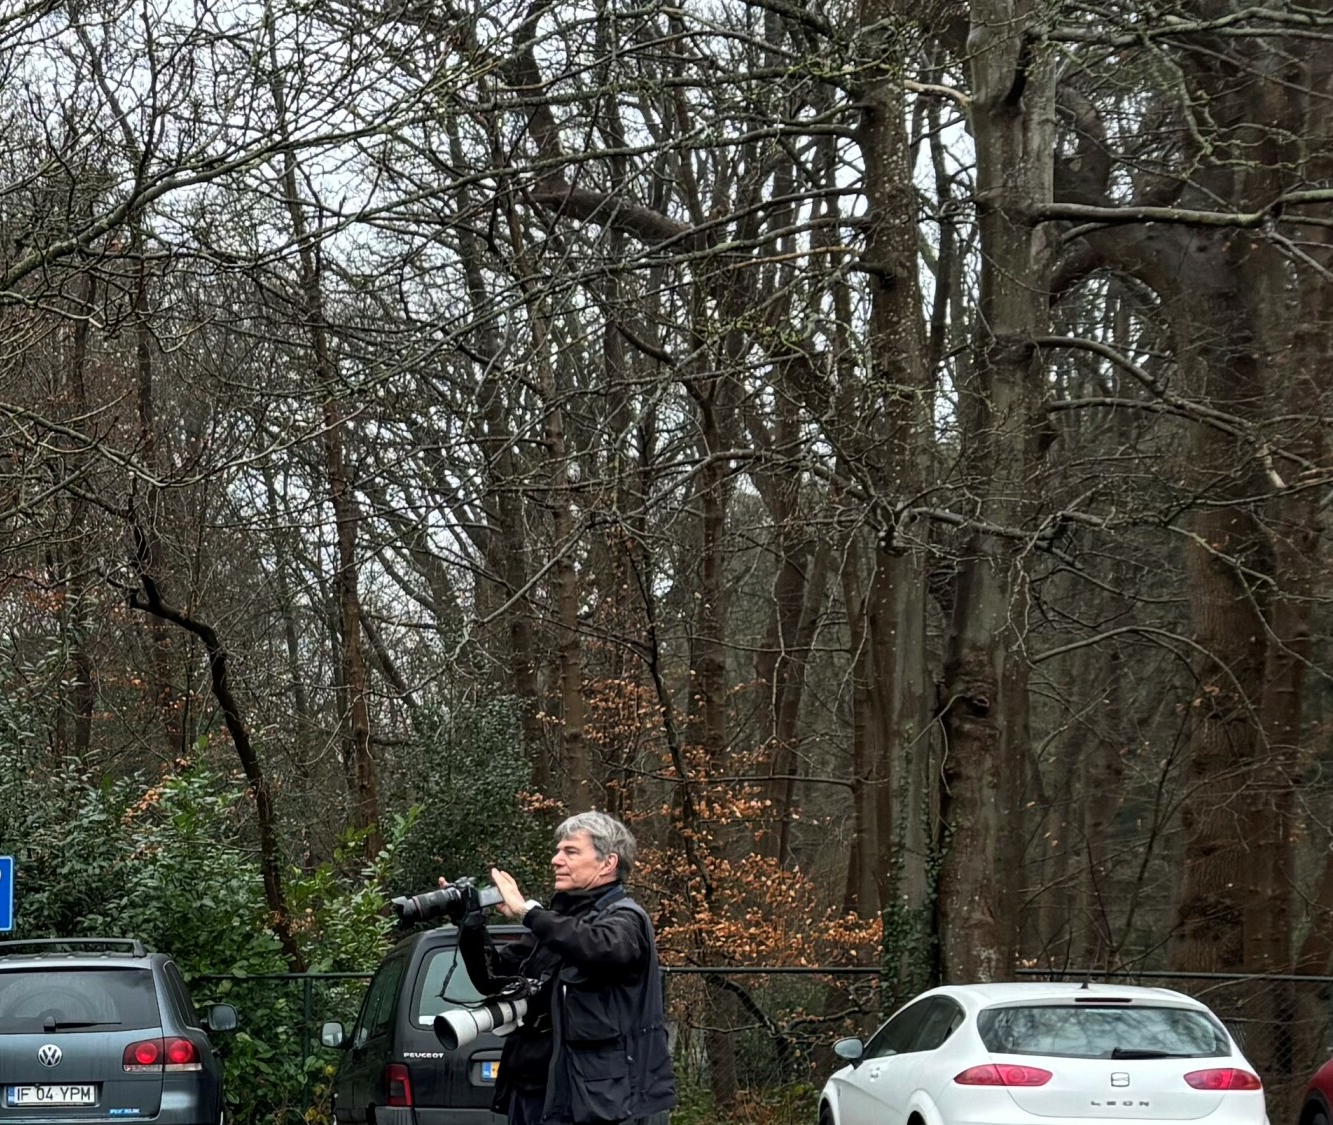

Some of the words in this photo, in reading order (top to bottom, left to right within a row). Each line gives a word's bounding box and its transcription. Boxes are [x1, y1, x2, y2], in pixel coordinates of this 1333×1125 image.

[17, 1087, 32, 1101] IF
[36, 1087, 54, 1101] 04
[59, 1086, 91, 1101] YPM
